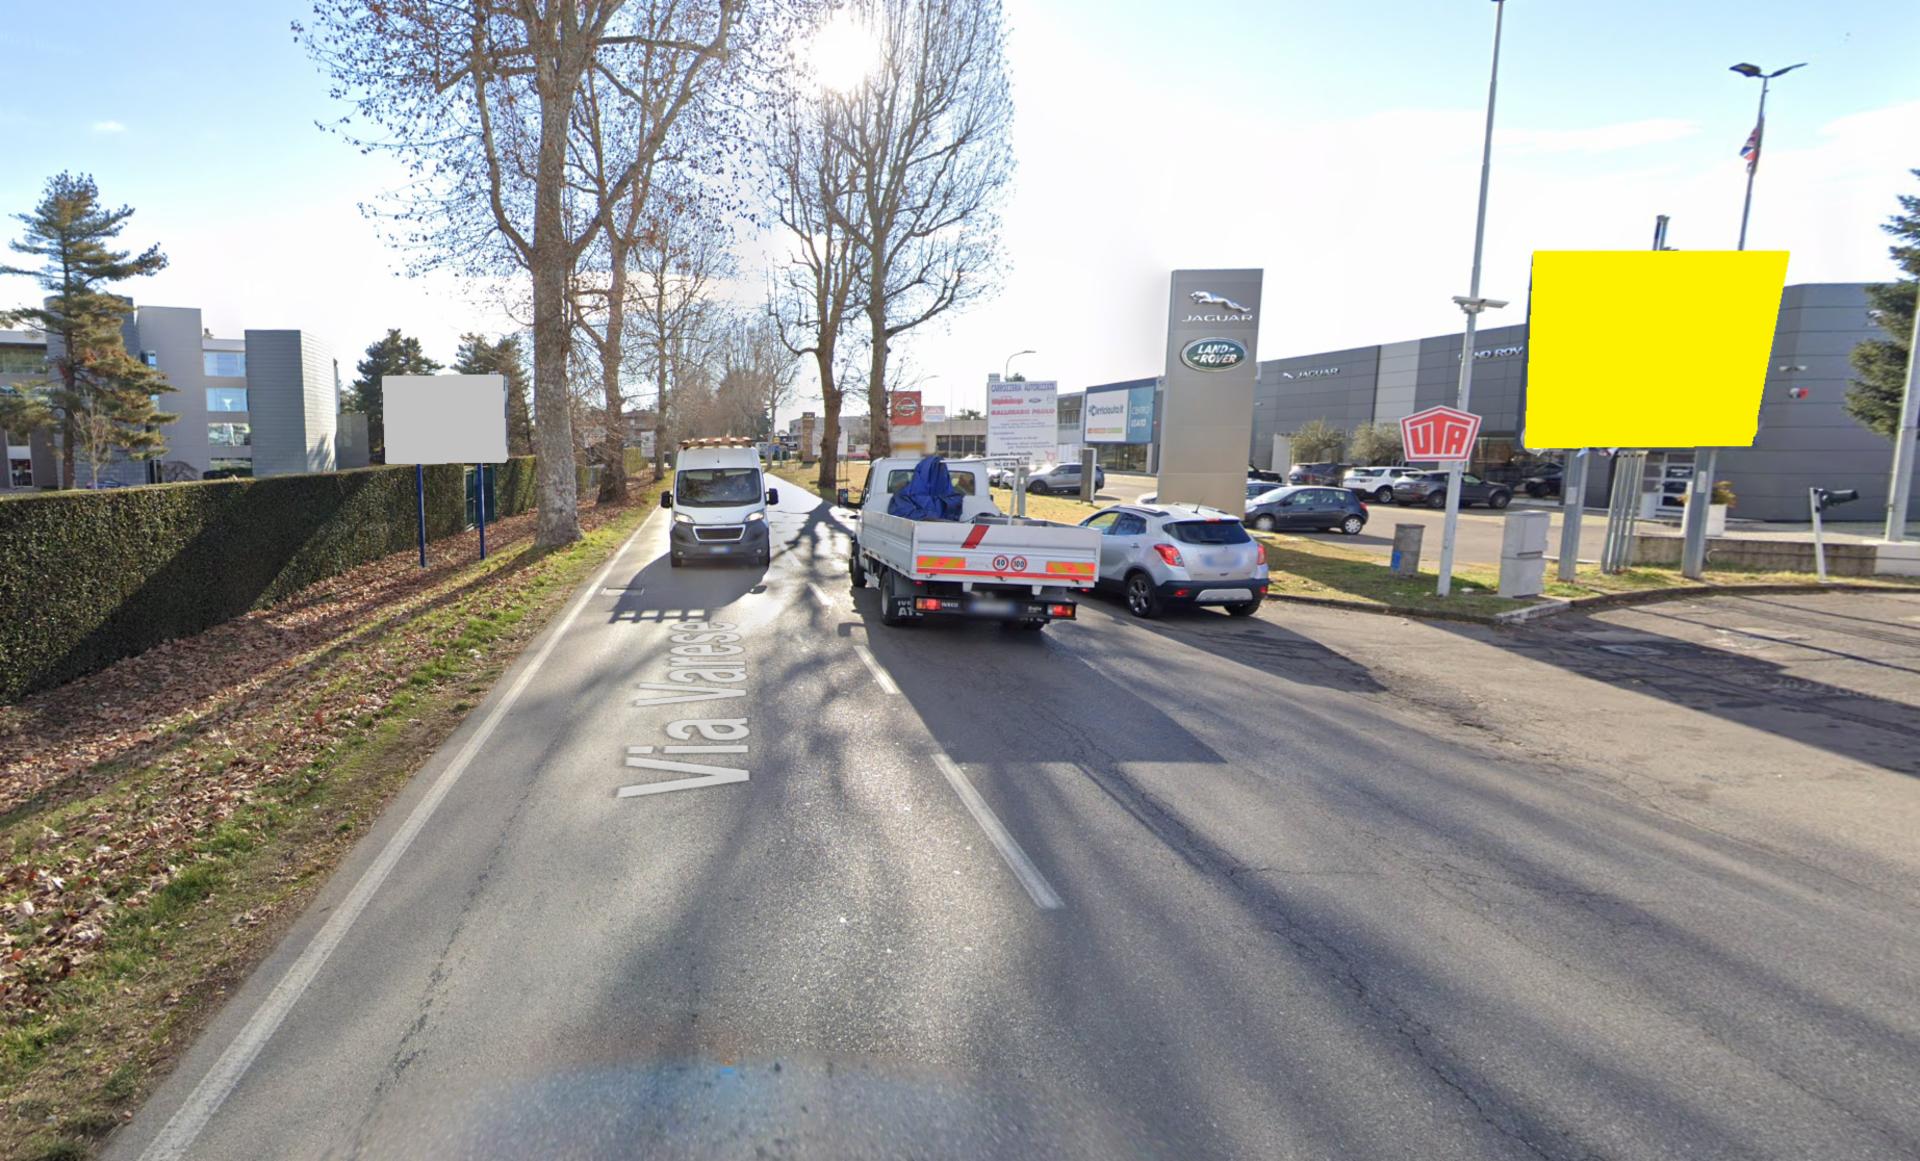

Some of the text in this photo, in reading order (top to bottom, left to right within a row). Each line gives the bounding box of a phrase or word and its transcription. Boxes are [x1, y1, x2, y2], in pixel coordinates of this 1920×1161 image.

[1182, 314, 1253, 322] JAGUAR
[1198, 344, 1228, 354] LAND
[1199, 354, 1237, 363] ROVER
[1296, 367, 1339, 378] JAGUAR
[1409, 411, 1471, 455] UTA
